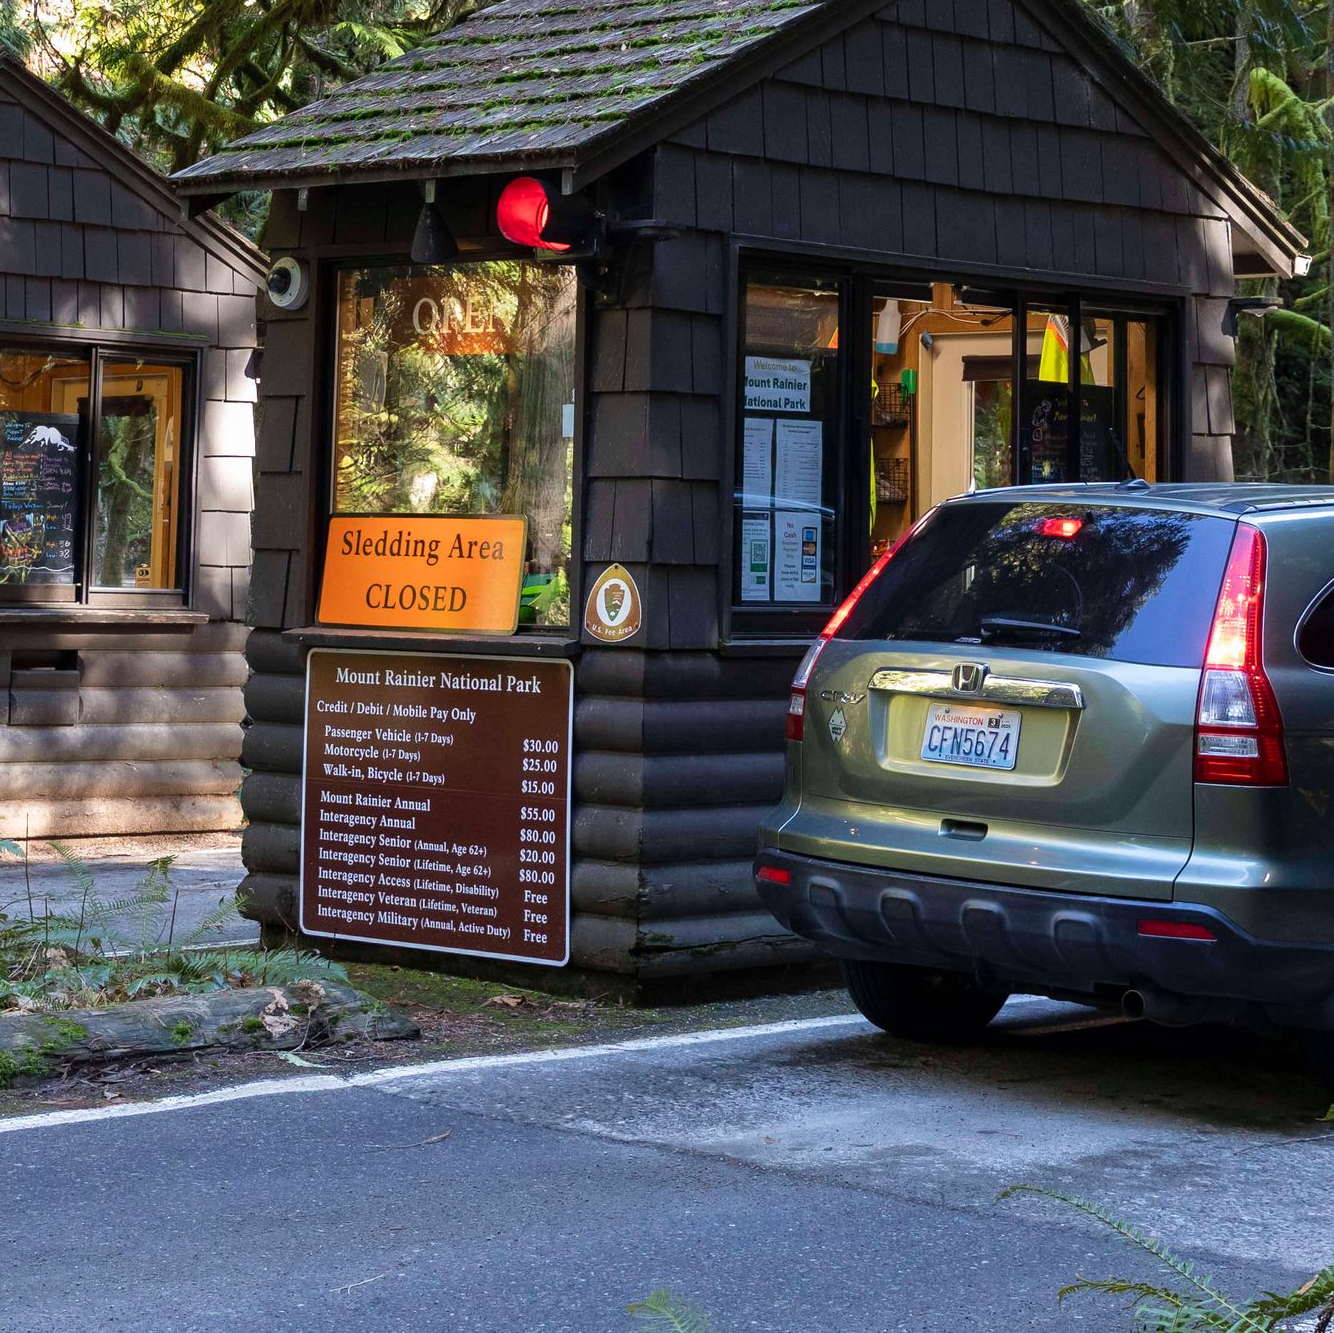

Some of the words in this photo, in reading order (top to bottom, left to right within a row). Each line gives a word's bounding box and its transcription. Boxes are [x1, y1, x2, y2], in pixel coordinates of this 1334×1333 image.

[745, 377, 771, 388] ount
[773, 378, 807, 391] Rainier
[745, 395, 781, 408] ational
[784, 398, 806, 410] Park
[341, 530, 440, 566] Sledding
[448, 534, 504, 561] Area
[366, 583, 467, 613] CLOSED
[592, 625, 602, 633] U.S.
[619, 625, 632, 634] Area
[336, 667, 380, 685] Mount
[385, 670, 436, 688] Rainier
[440, 673, 502, 692] National
[507, 675, 541, 694] Park
[317, 701, 347, 713] Credit
[350, 702, 354, 714] /
[357, 702, 384, 715] Debit
[386, 704, 390, 716] /
[393, 704, 427, 718] Mobile
[430, 706, 449, 721] Pay
[452, 708, 476, 724] Only
[935, 713, 983, 725] WASHINGTON
[324, 726, 372, 741] Passenger
[376, 728, 411, 743] Vehicle
[414, 732, 429, 743] (1-7
[431, 733, 454, 746] Days)
[928, 725, 1010, 760] CFN5674
[324, 744, 378, 759] Motorcycle
[382, 748, 397, 760] (1-7
[398, 749, 421, 762] Days)
[523, 739, 558, 754] $30.00
[523, 758, 557, 773] $25.00
[945, 754, 972, 762] EVERGREEN
[323, 763, 364, 780] Walk-in,
[367, 766, 403, 781] Bicycle
[406, 771, 420, 782] (1-7
[422, 772, 445, 786] Days)
[522, 779, 554, 795] $15.00
[320, 790, 353, 804] Mount
[355, 793, 392, 808] Rainier
[394, 798, 431, 812] Annual
[320, 809, 377, 827] Interagency
[380, 816, 416, 830] Annual
[520, 806, 555, 823] $55.00
[319, 828, 377, 848] Interagency
[378, 833, 411, 849] Senior
[414, 839, 449, 855] (Annual,
[451, 845, 467, 856] Age
[469, 845, 487, 858] 62+)
[520, 828, 556, 844] $80.00
[318, 847, 376, 867] Interagency
[378, 853, 411, 868] Senior
[414, 858, 453, 874] (Lifetime,
[456, 864, 472, 876] Age
[473, 865, 492, 878] 62+)
[519, 849, 555, 865] $20.00
[318, 866, 376, 887] Interagency
[378, 873, 411, 888] Access
[413, 879, 454, 894] (Lifetime,
[455, 882, 499, 899] Disability)
[519, 868, 555, 885] $80.00
[318, 885, 375, 905] Interagency
[378, 891, 417, 908] Veteran
[419, 898, 459, 914] (Lifetime,
[461, 902, 497, 918] Veteran)
[524, 889, 548, 904] Free
[317, 903, 375, 925] Interagency
[377, 911, 418, 930] Military
[420, 917, 456, 932] (Annual,
[459, 921, 485, 935] Active
[487, 924, 511, 939] Duty)
[524, 909, 547, 924] Free
[523, 929, 547, 944] Free
